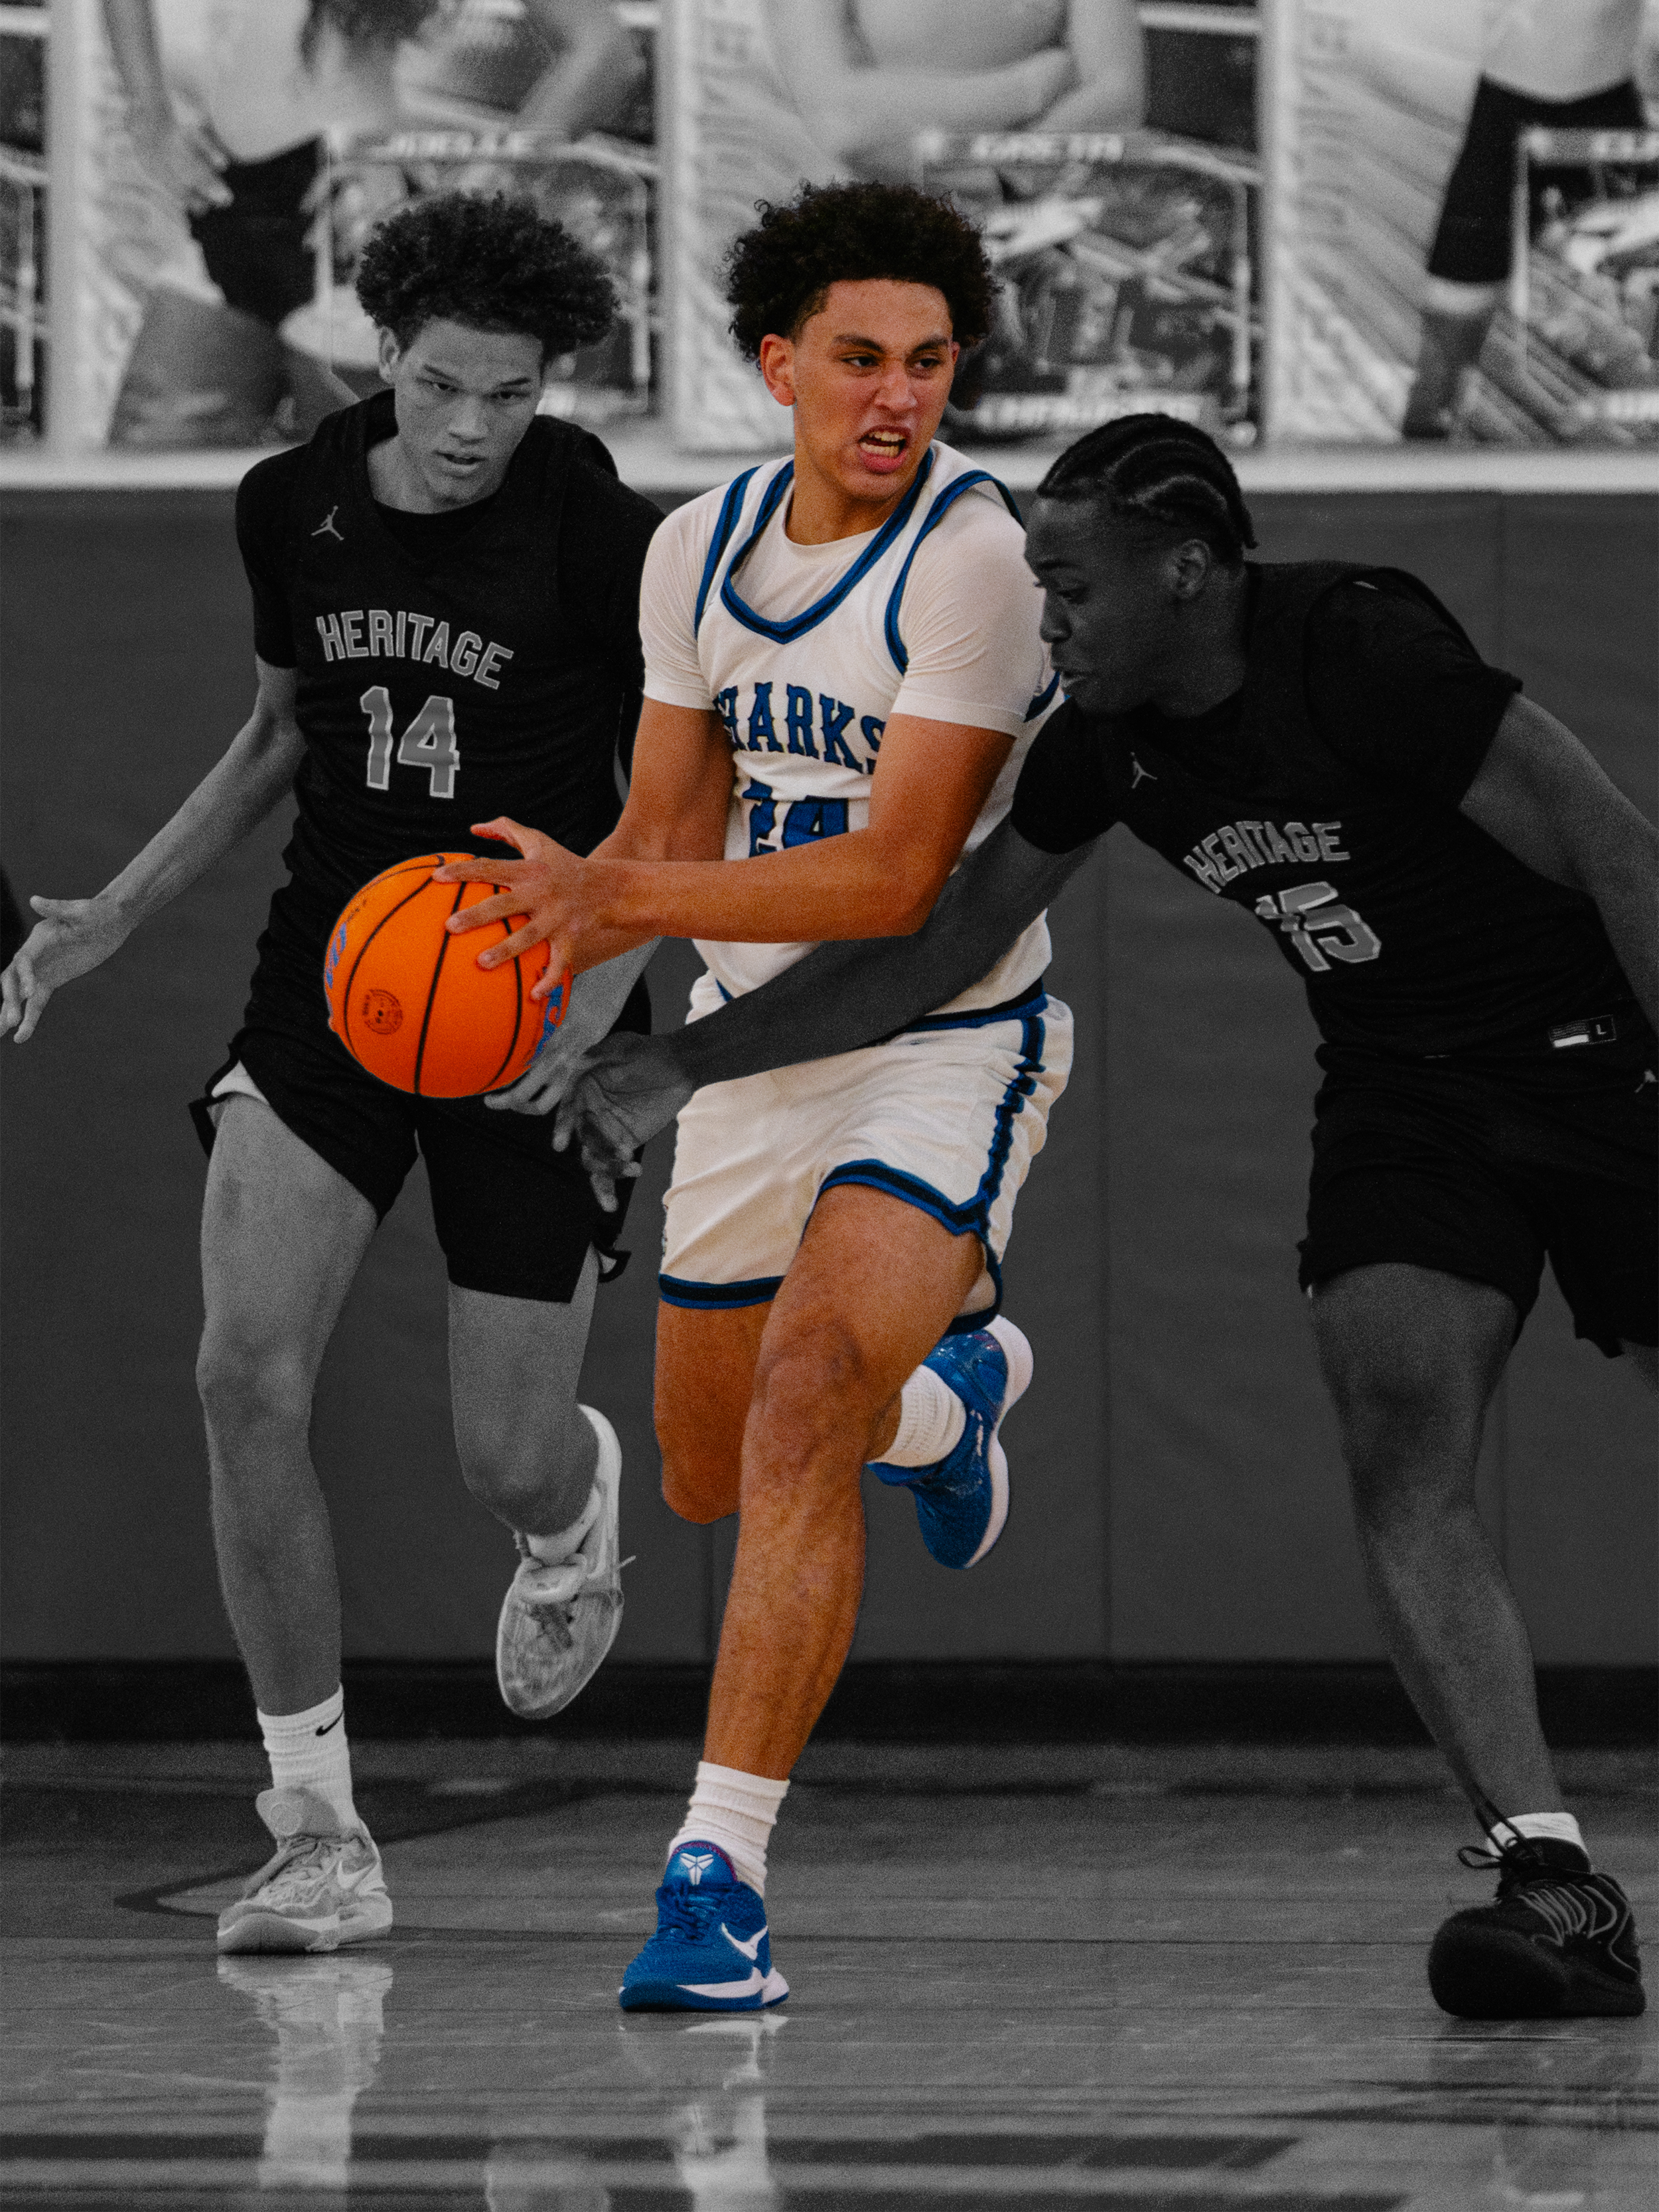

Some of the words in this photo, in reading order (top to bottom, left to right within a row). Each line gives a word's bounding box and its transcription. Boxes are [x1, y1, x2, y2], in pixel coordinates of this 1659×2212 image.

[316, 610, 514, 690] HERITAGE
[360, 686, 460, 798] 14
[1183, 821, 1350, 894] HERITAGE
[1255, 881, 1382, 972] 15
